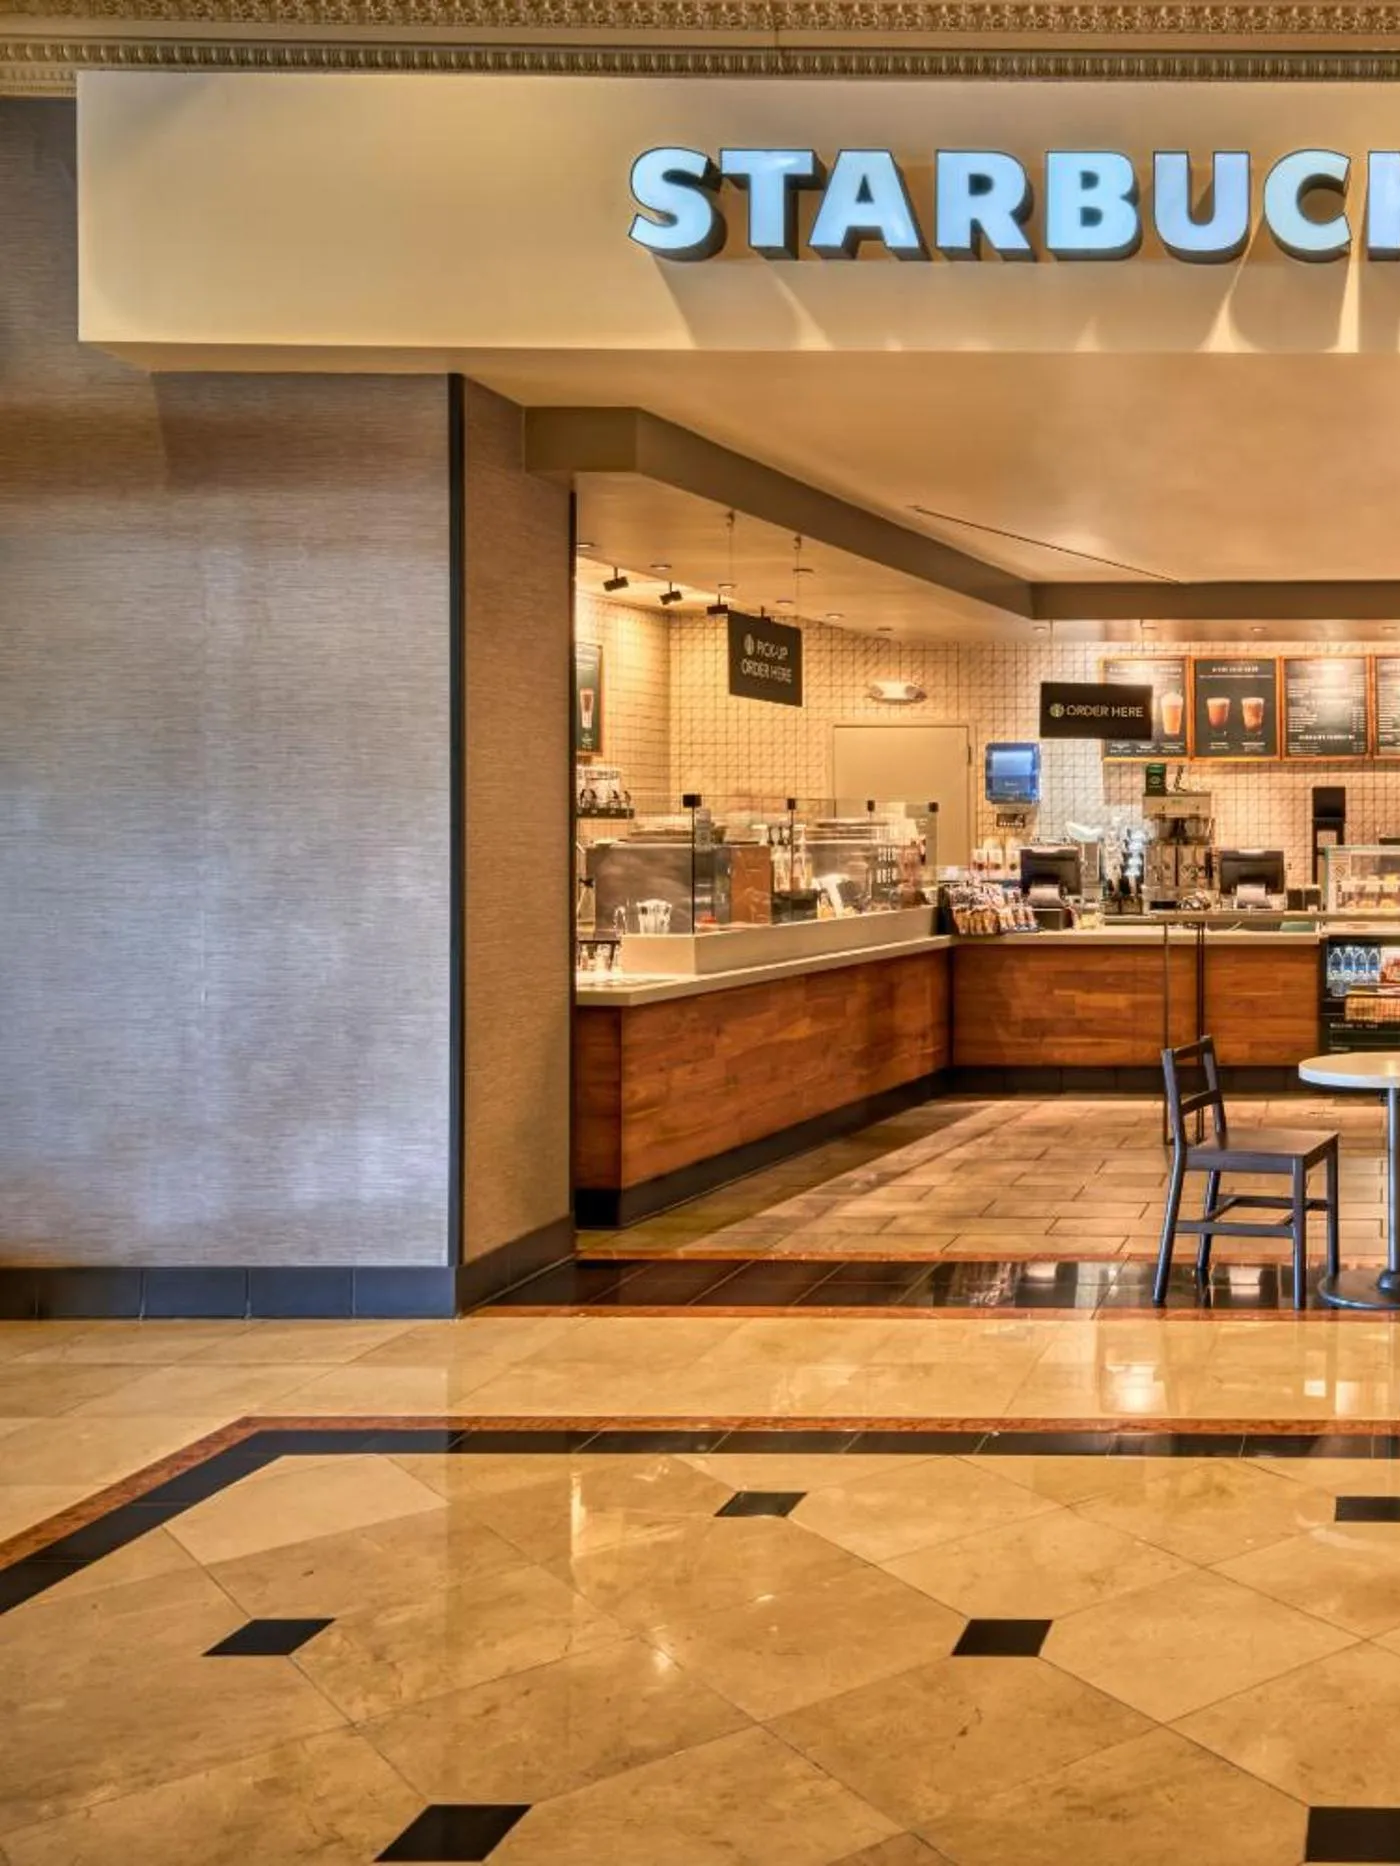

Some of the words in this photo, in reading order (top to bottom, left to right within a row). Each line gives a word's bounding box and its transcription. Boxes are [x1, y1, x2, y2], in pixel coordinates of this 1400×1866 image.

[742, 658, 770, 679] ORDER
[770, 665, 793, 684] HERE
[1066, 704, 1109, 717] ORDER
[1111, 706, 1145, 718] HERE
